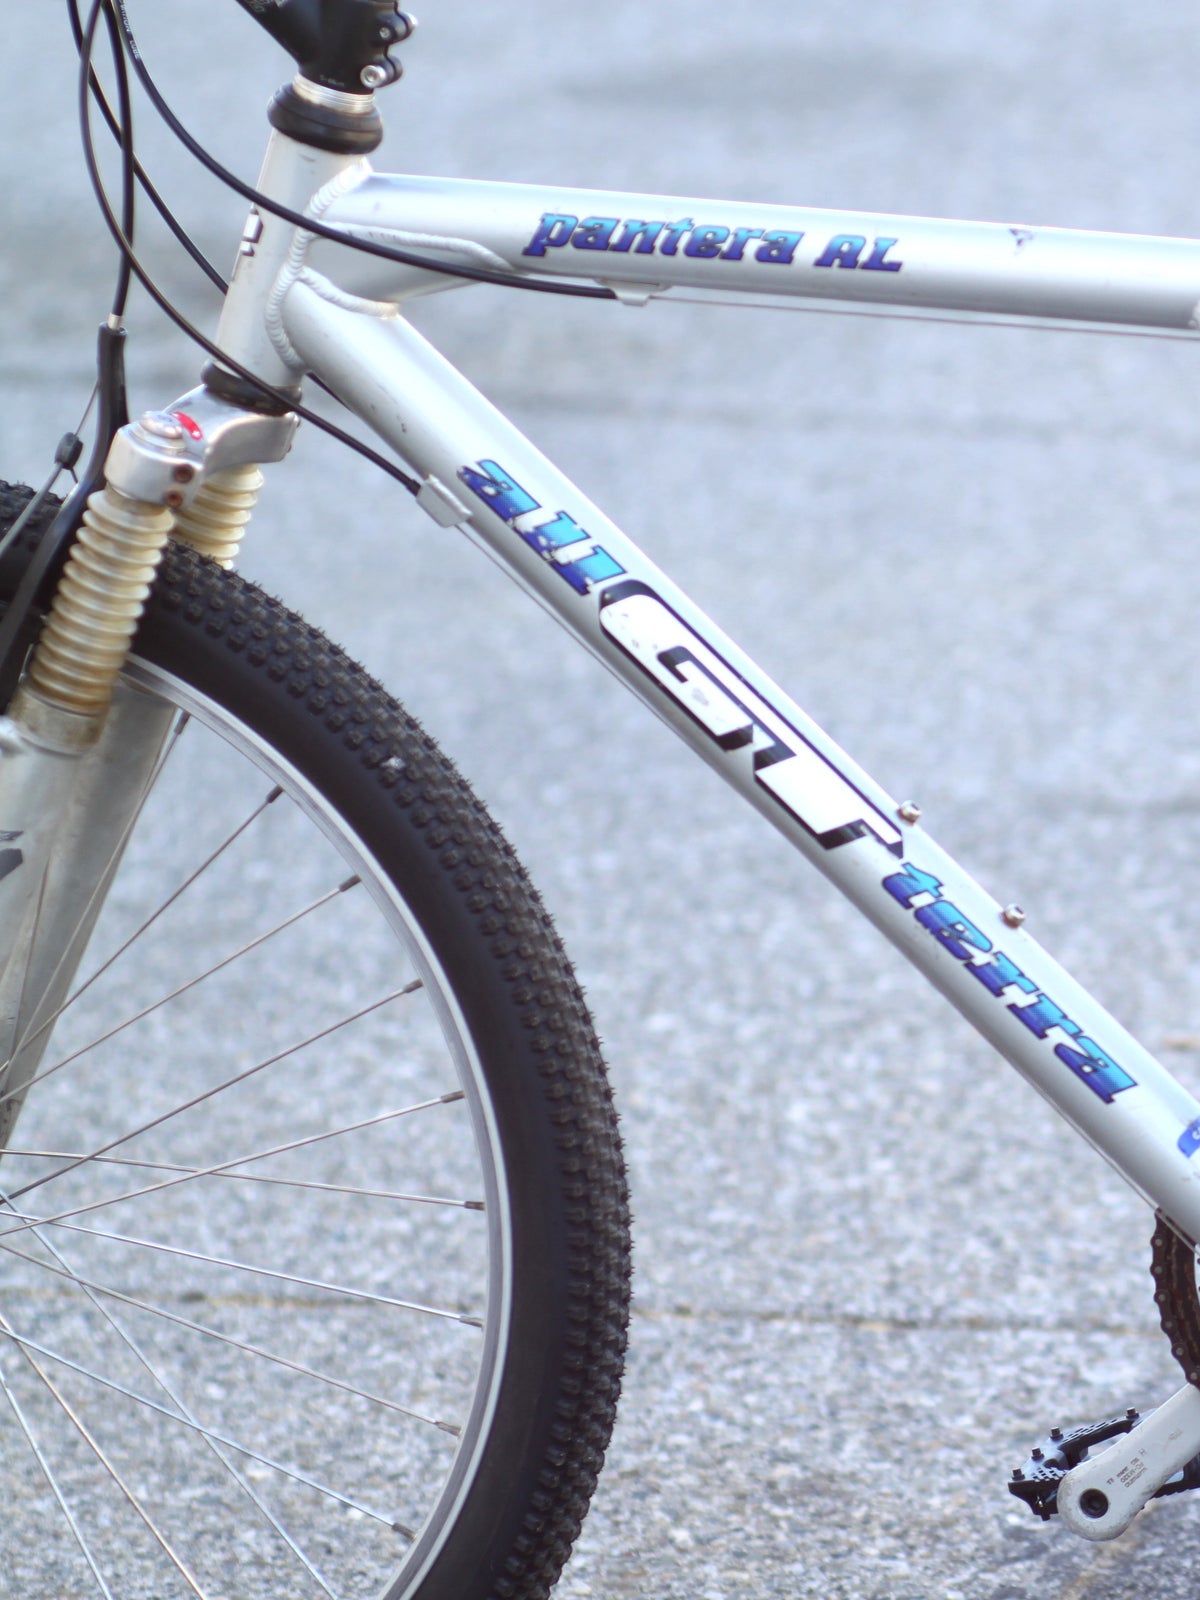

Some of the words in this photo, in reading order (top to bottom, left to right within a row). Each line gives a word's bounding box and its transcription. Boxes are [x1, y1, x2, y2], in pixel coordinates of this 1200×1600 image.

[522, 213, 806, 264] pantera
[813, 234, 904, 272] AL
[457, 459, 627, 596] all
[600, 579, 904, 860] GT
[882, 862, 1138, 1104] terra
